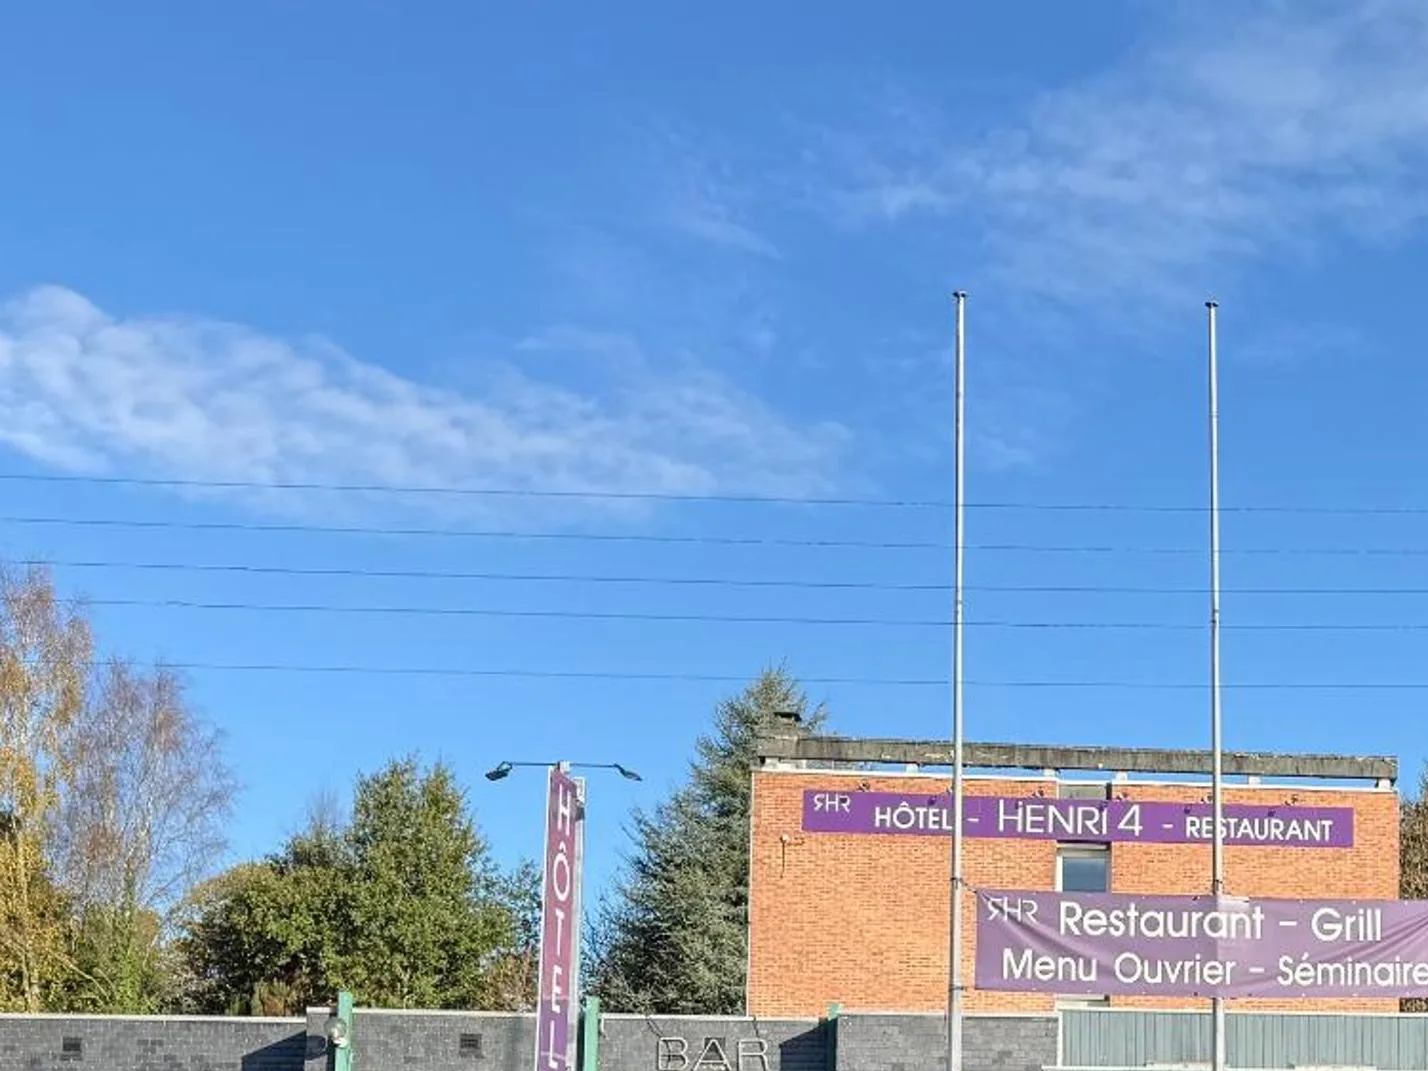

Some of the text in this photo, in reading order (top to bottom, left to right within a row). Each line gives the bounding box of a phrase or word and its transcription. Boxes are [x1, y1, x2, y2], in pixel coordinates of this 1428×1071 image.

[874, 801, 953, 830] HÔTEL
[998, 799, 1109, 835] HENRI
[1117, 804, 1144, 836] 4
[1186, 816, 1334, 841] RESTAURANT
[548, 783, 571, 1071] HÔTEL
[1060, 901, 1265, 940] Restaurant
[1311, 907, 1383, 942] Grill
[1002, 948, 1096, 982] Menu
[1115, 952, 1237, 985] Ouvrier
[657, 1036, 769, 1071] BAR
